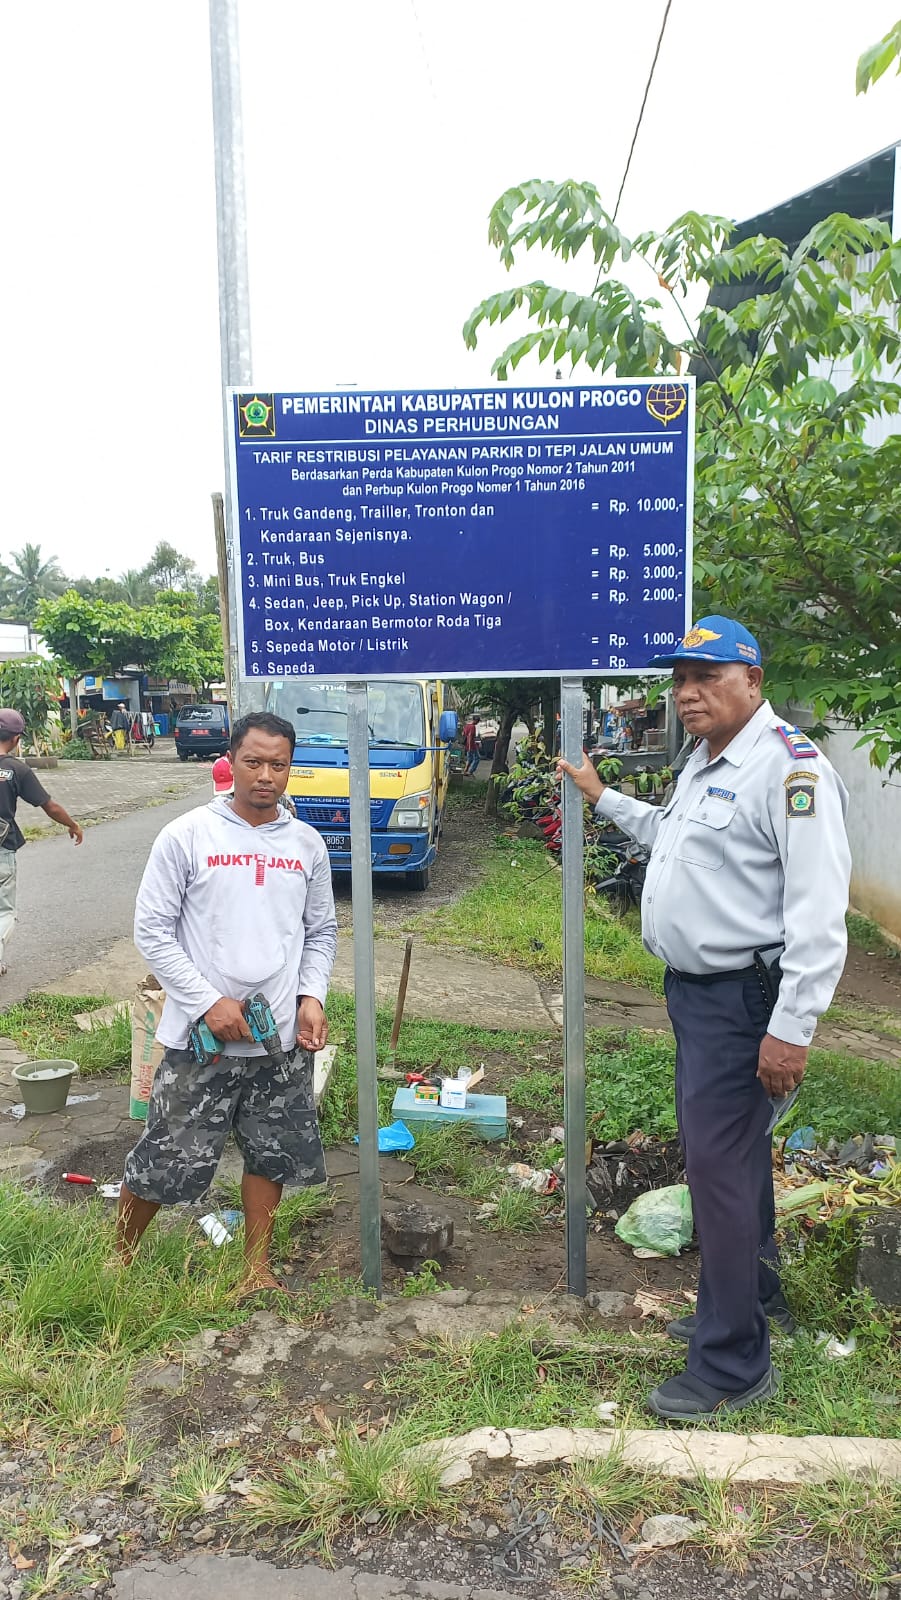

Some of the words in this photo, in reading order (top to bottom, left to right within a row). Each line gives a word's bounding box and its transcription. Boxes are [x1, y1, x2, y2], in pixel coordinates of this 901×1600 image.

[282, 396, 396, 414] PEMERINTAH
[401, 393, 506, 412] KABUPATEN
[513, 391, 574, 409] KULON
[580, 389, 642, 407] PROGO
[365, 419, 418, 433] DINAS
[424, 415, 559, 432] PERHUBUNGAN
[253, 452, 293, 463] TARIF
[297, 450, 381, 462] RESTRIBUSI
[385, 448, 468, 461] PELAYANAN
[472, 446, 524, 459] PARKIR
[528, 446, 541, 457] DI
[545, 445, 576, 456] TEPI
[580, 443, 626, 456] JALAN
[631, 442, 674, 454] UMUM
[292, 468, 359, 480] Berdasarkan
[363, 467, 393, 478] Perda
[397, 467, 454, 480] Kabupaten
[457, 465, 489, 476] Kulon
[492, 465, 524, 478] Progo
[527, 464, 564, 474] Nomor
[566, 463, 573, 473] 2
[576, 462, 609, 473] Tahun
[612, 461, 635, 472] 2011
[343, 485, 363, 495] dan
[366, 484, 404, 497] Perbup
[407, 483, 439, 494] Kulon
[442, 482, 474, 496] Progo
[477, 482, 513, 492] Nomer
[515, 480, 521, 491] 1
[525, 480, 557, 491] Tahun
[560, 479, 586, 490] 2016
[246, 508, 256, 520] 1.
[260, 507, 290, 520] Truk
[294, 507, 357, 521] Gandeng,
[361, 505, 411, 519] Trailler,
[415, 505, 466, 517] Tronton
[471, 504, 494, 516] dan
[610, 500, 630, 514] Rp.
[637, 498, 684, 512] 10.000,-
[261, 530, 331, 542] Kendaraan
[336, 528, 412, 544] Sejenisnya.
[247, 553, 258, 565] 2.
[262, 552, 295, 566] Truk,
[300, 552, 325, 564] Bus
[610, 545, 630, 560] Rp.
[644, 543, 683, 557] 5.000,-
[249, 575, 259, 587] 3.
[264, 575, 291, 587] Mini
[295, 574, 324, 587] Bus,
[328, 574, 357, 585] Truk
[361, 572, 405, 588] Engkel
[610, 568, 629, 582] Rp.
[644, 566, 683, 579] 3.000,-
[249, 597, 260, 609] 4.
[265, 597, 309, 610] Sedan,
[313, 596, 348, 610] Jeep,
[352, 595, 380, 607] Pick
[384, 595, 405, 609] Up,
[410, 594, 456, 606] Station
[460, 593, 504, 607] Wagon
[610, 590, 629, 604] Rp.
[644, 588, 683, 601] 2.000,-
[265, 619, 294, 632] Box,
[298, 618, 368, 630] Kendaraan
[372, 617, 433, 628] Bermotor
[437, 615, 470, 627] Roda
[474, 615, 502, 629] Tiga
[252, 641, 263, 653] 5.
[267, 640, 314, 655] Sepeda
[319, 640, 356, 651] Motor
[368, 638, 409, 650] Listrik
[610, 634, 629, 648] Rp.
[252, 663, 263, 674] 6.
[267, 662, 315, 675] Sepeda
[609, 656, 629, 669] Rp.
[326, 836, 345, 845] 8063
[267, 857, 304, 871] JAYA
